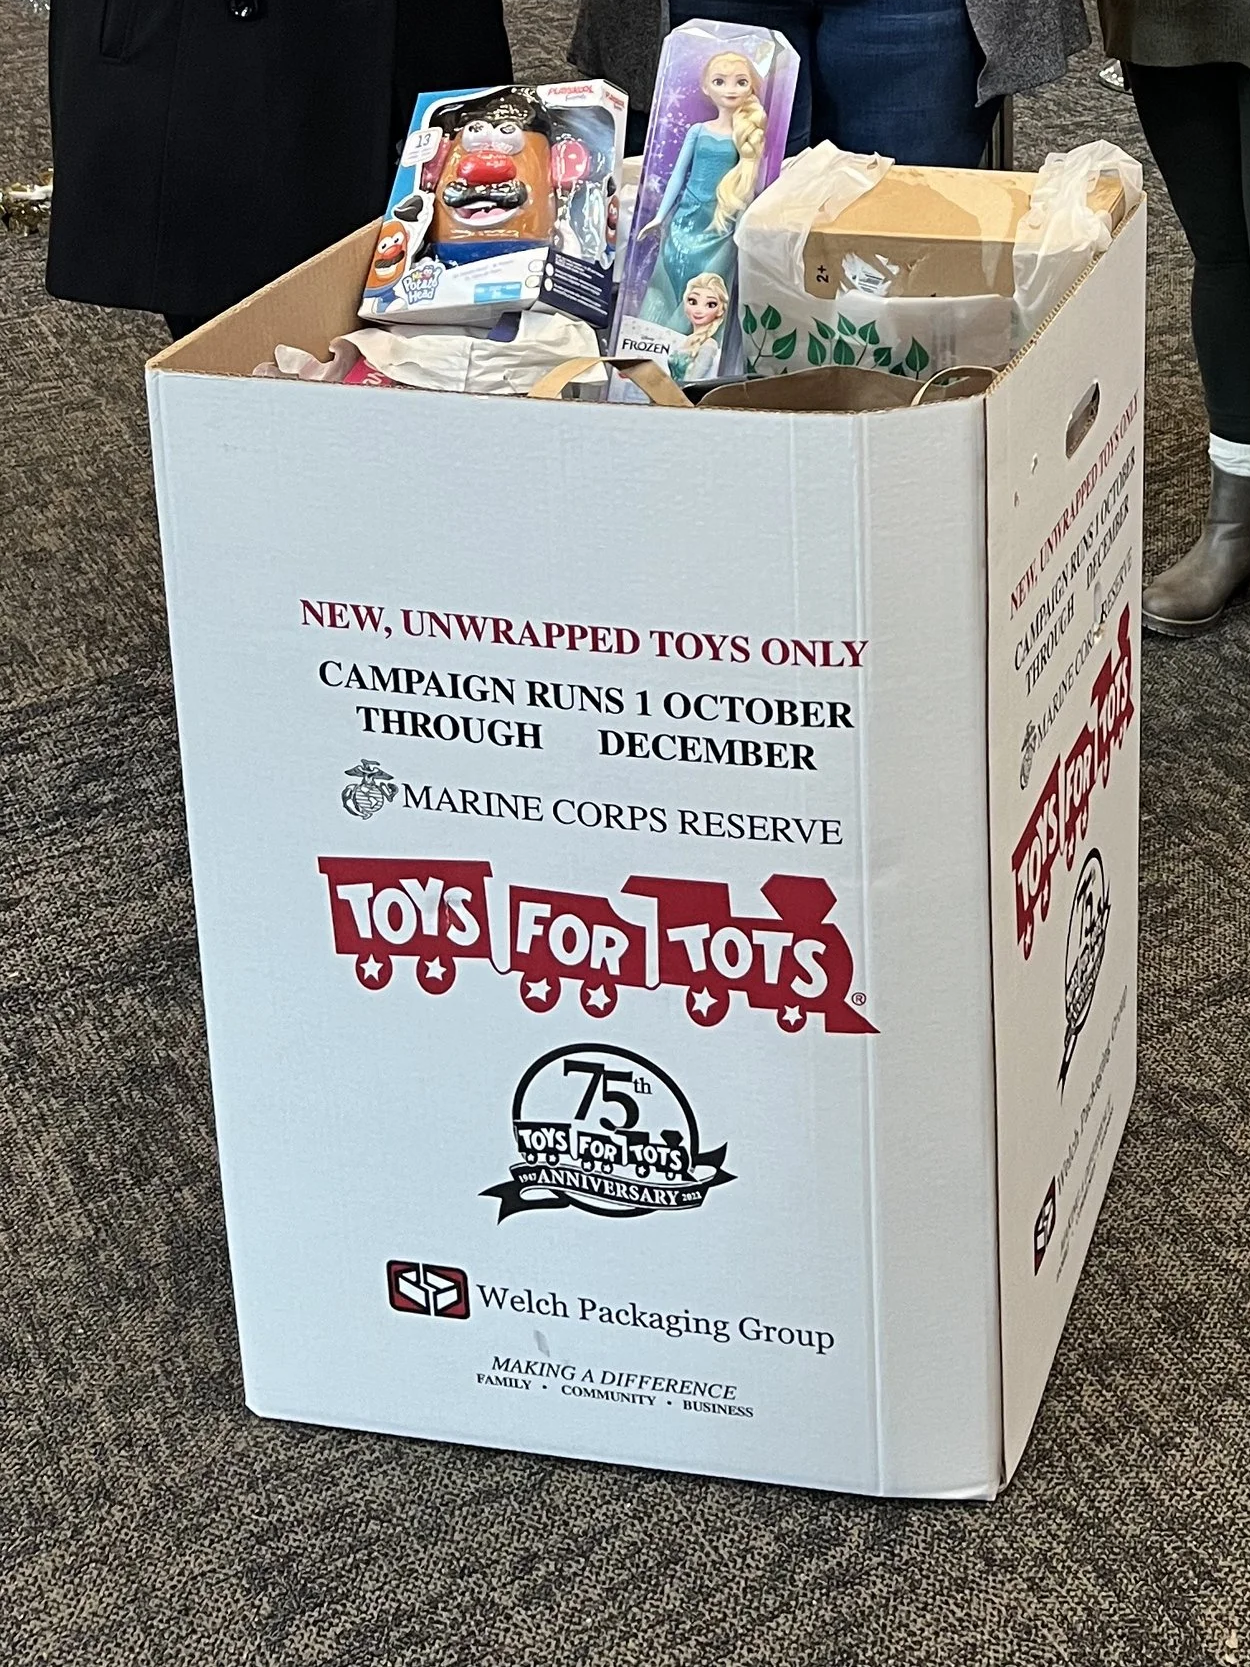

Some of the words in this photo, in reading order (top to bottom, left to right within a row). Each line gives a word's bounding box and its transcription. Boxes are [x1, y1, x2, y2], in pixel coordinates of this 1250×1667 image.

[415, 135, 431, 149] 13
[409, 289, 436, 305] Head
[816, 265, 829, 283] 2+
[622, 338, 671, 355] FROZEN
[1010, 559, 1038, 622] NEW,
[1040, 462, 1098, 572] UNWRAPPED
[1098, 428, 1120, 479] TOYS
[1120, 388, 1139, 440] ONLY
[1014, 565, 1070, 673] CAMPAIGN
[1069, 525, 1094, 583] RUNS
[1100, 445, 1136, 525] OCTOBER
[1025, 591, 1076, 698] THROUGH
[1086, 494, 1130, 591] DECEMBER
[300, 599, 393, 638] NEW,
[401, 608, 640, 656] UNWRAPPED
[650, 631, 750, 663] TOYS
[761, 637, 870, 668] ONLY
[1036, 664, 1074, 749] MARINE
[1099, 545, 1133, 626] RESERVE
[318, 661, 516, 706] CAMPAIGN
[527, 681, 624, 714] RUNS
[635, 690, 653, 717] 1
[663, 691, 855, 729] OCTOBER
[356, 705, 544, 749] THROUGH
[599, 729, 817, 771] DECEMBER
[402, 783, 544, 822] MARINE
[552, 799, 668, 835] CORPS
[677, 809, 845, 846] RESERVE
[1018, 792, 1057, 911] TOYS
[1065, 744, 1092, 824] FOR
[1099, 656, 1129, 742] TOTS
[336, 877, 481, 947] TOYS
[515, 901, 629, 976] FOR
[668, 925, 829, 998] TOTS
[518, 1126, 568, 1155] TOYS
[578, 1135, 617, 1164] FOR
[629, 1144, 682, 1173] TOTS
[518, 1173, 537, 1184] 1947
[537, 1168, 680, 1206] ANNIVERSARY
[476, 1283, 568, 1319] Welch
[578, 1298, 731, 1343] Packaging
[739, 1316, 835, 1356] Group
[476, 1372, 532, 1392] FAMILY
[561, 1384, 658, 1407] COMMUNITY
[683, 1399, 755, 1419] BUSINESS
[492, 1355, 576, 1381] MAKING
[582, 1368, 595, 1383] A
[600, 1370, 738, 1402] DIFFERENCE
